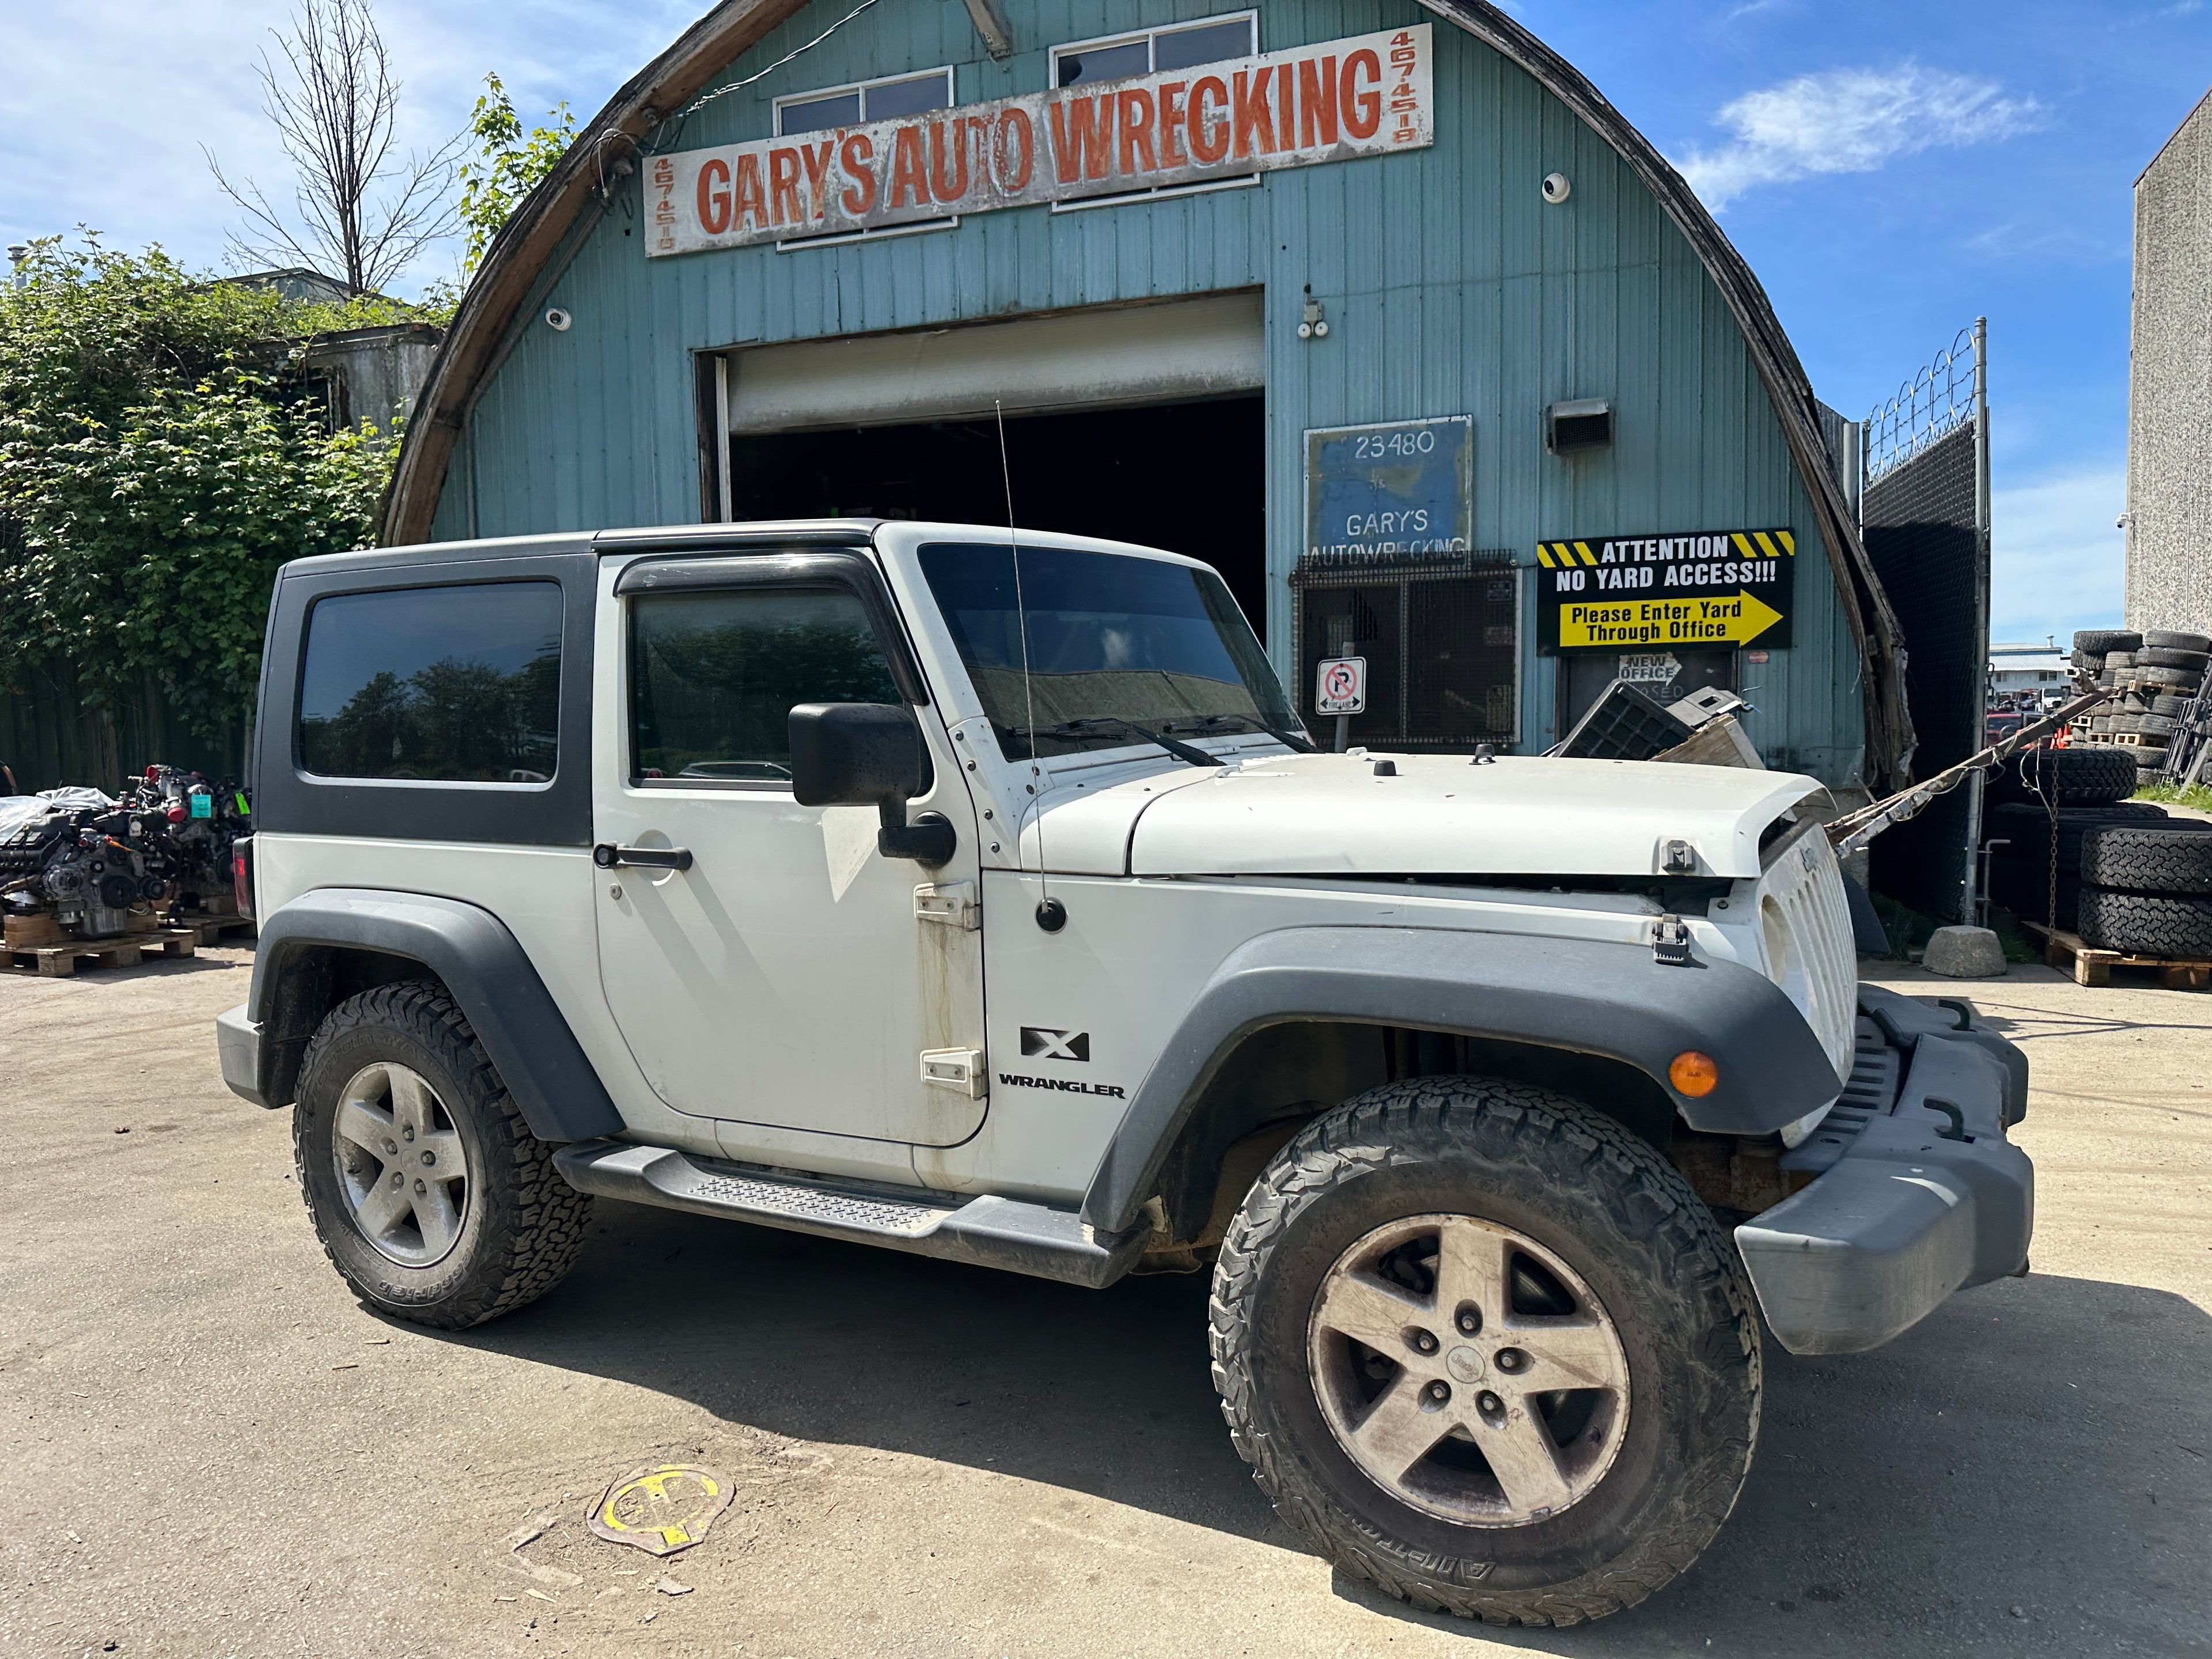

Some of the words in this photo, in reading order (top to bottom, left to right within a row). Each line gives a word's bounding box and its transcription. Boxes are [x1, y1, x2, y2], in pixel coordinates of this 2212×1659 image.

[696, 130, 876, 235] GARY'S
[891, 107, 1034, 209] AUTO
[1050, 48, 1381, 183] WRECKING
[1355, 431, 1434, 459] 23480
[1347, 509, 1428, 536] GARY'S
[1601, 535, 1728, 563] ATTENTION
[1556, 570, 1585, 592] NO
[1596, 567, 1653, 589] YARD
[1664, 560, 1775, 586] ACCESS!!!
[1572, 607, 1631, 624] Please
[1641, 603, 1690, 621] Enter
[1700, 600, 1741, 618] Yard
[1586, 623, 1660, 642] Through
[1670, 620, 1726, 638] Office
[1620, 666, 1674, 679] OFFICE
[1628, 656, 1665, 667] NEW
[999, 1073, 1126, 1099] WRANGLER
[1451, 1354, 1479, 1378] Jeep
